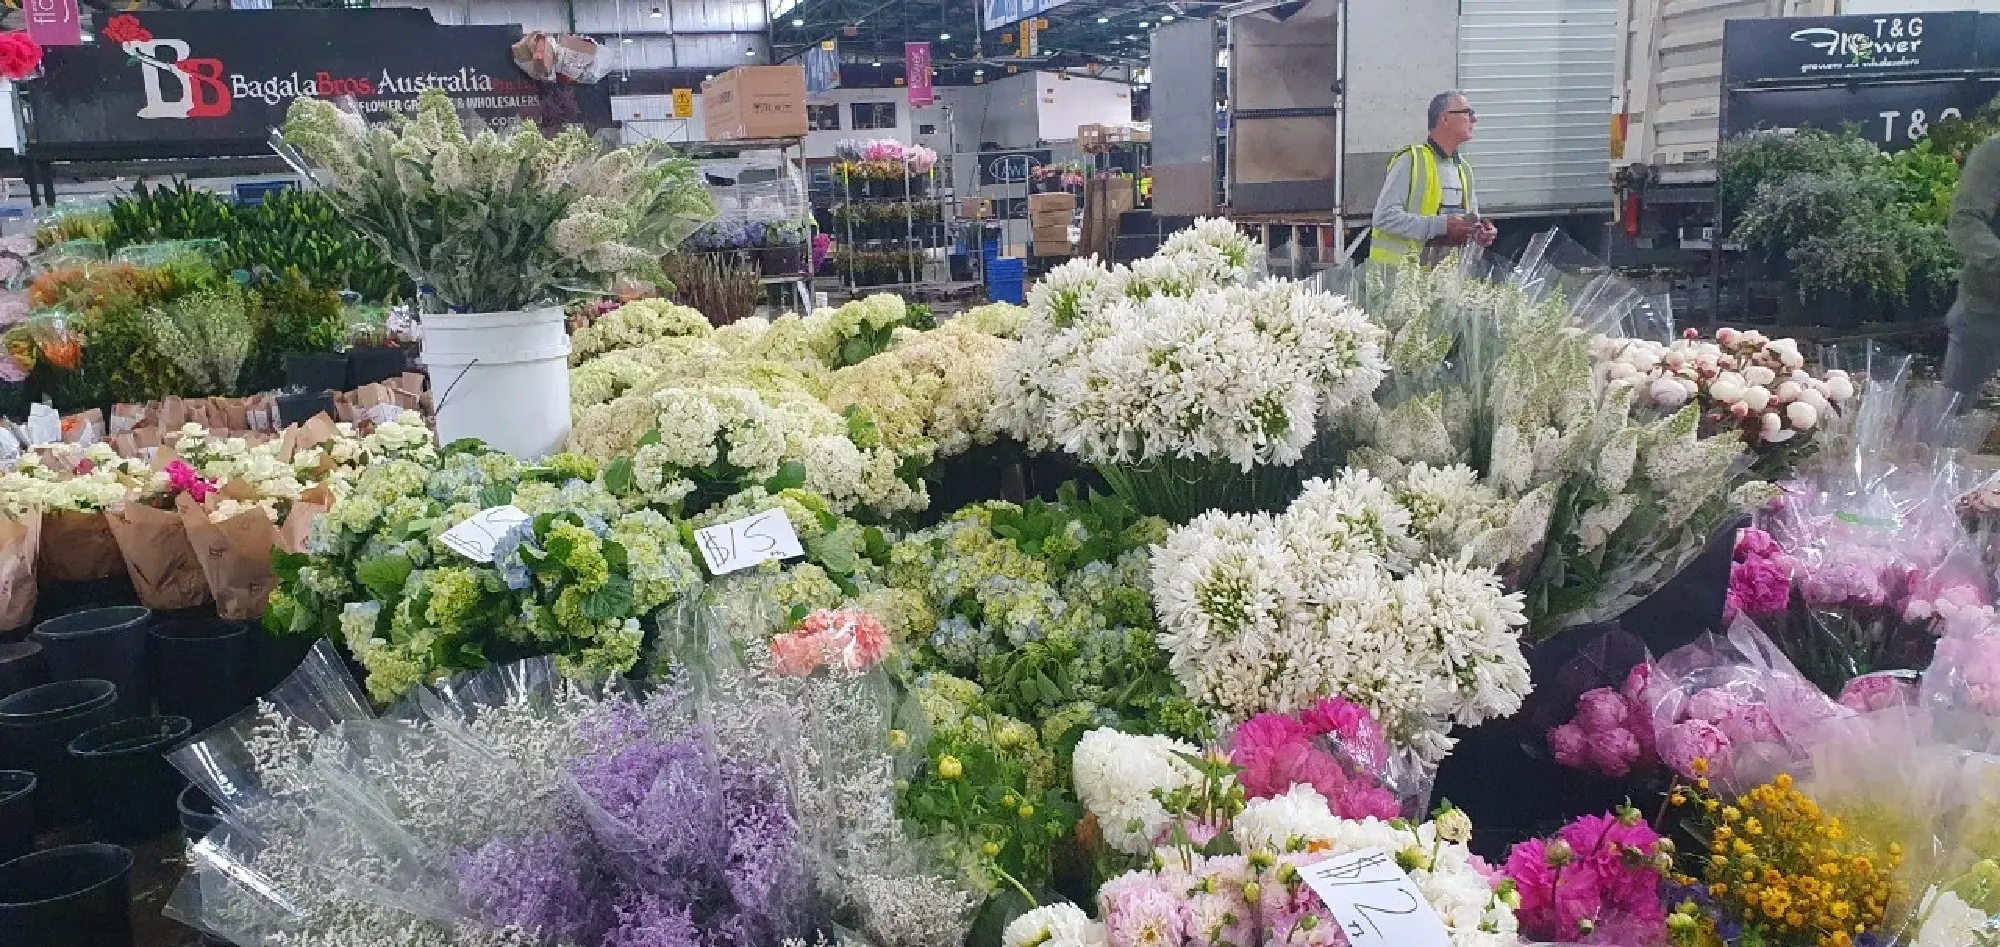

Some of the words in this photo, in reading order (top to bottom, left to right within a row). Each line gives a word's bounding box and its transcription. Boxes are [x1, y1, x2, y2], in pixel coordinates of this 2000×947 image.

[1790, 27, 1923, 55] Flower
[1873, 18, 1887, 38] T
[1890, 18, 1904, 37] &
[1908, 17, 1923, 37] G
[360, 99, 403, 113] FLOWER
[466, 95, 540, 109] WHOLESALERS
[1879, 110, 1901, 142] T
[1907, 108, 1929, 140] &
[700, 515, 777, 569] $15
[1315, 852, 1419, 940] $12
